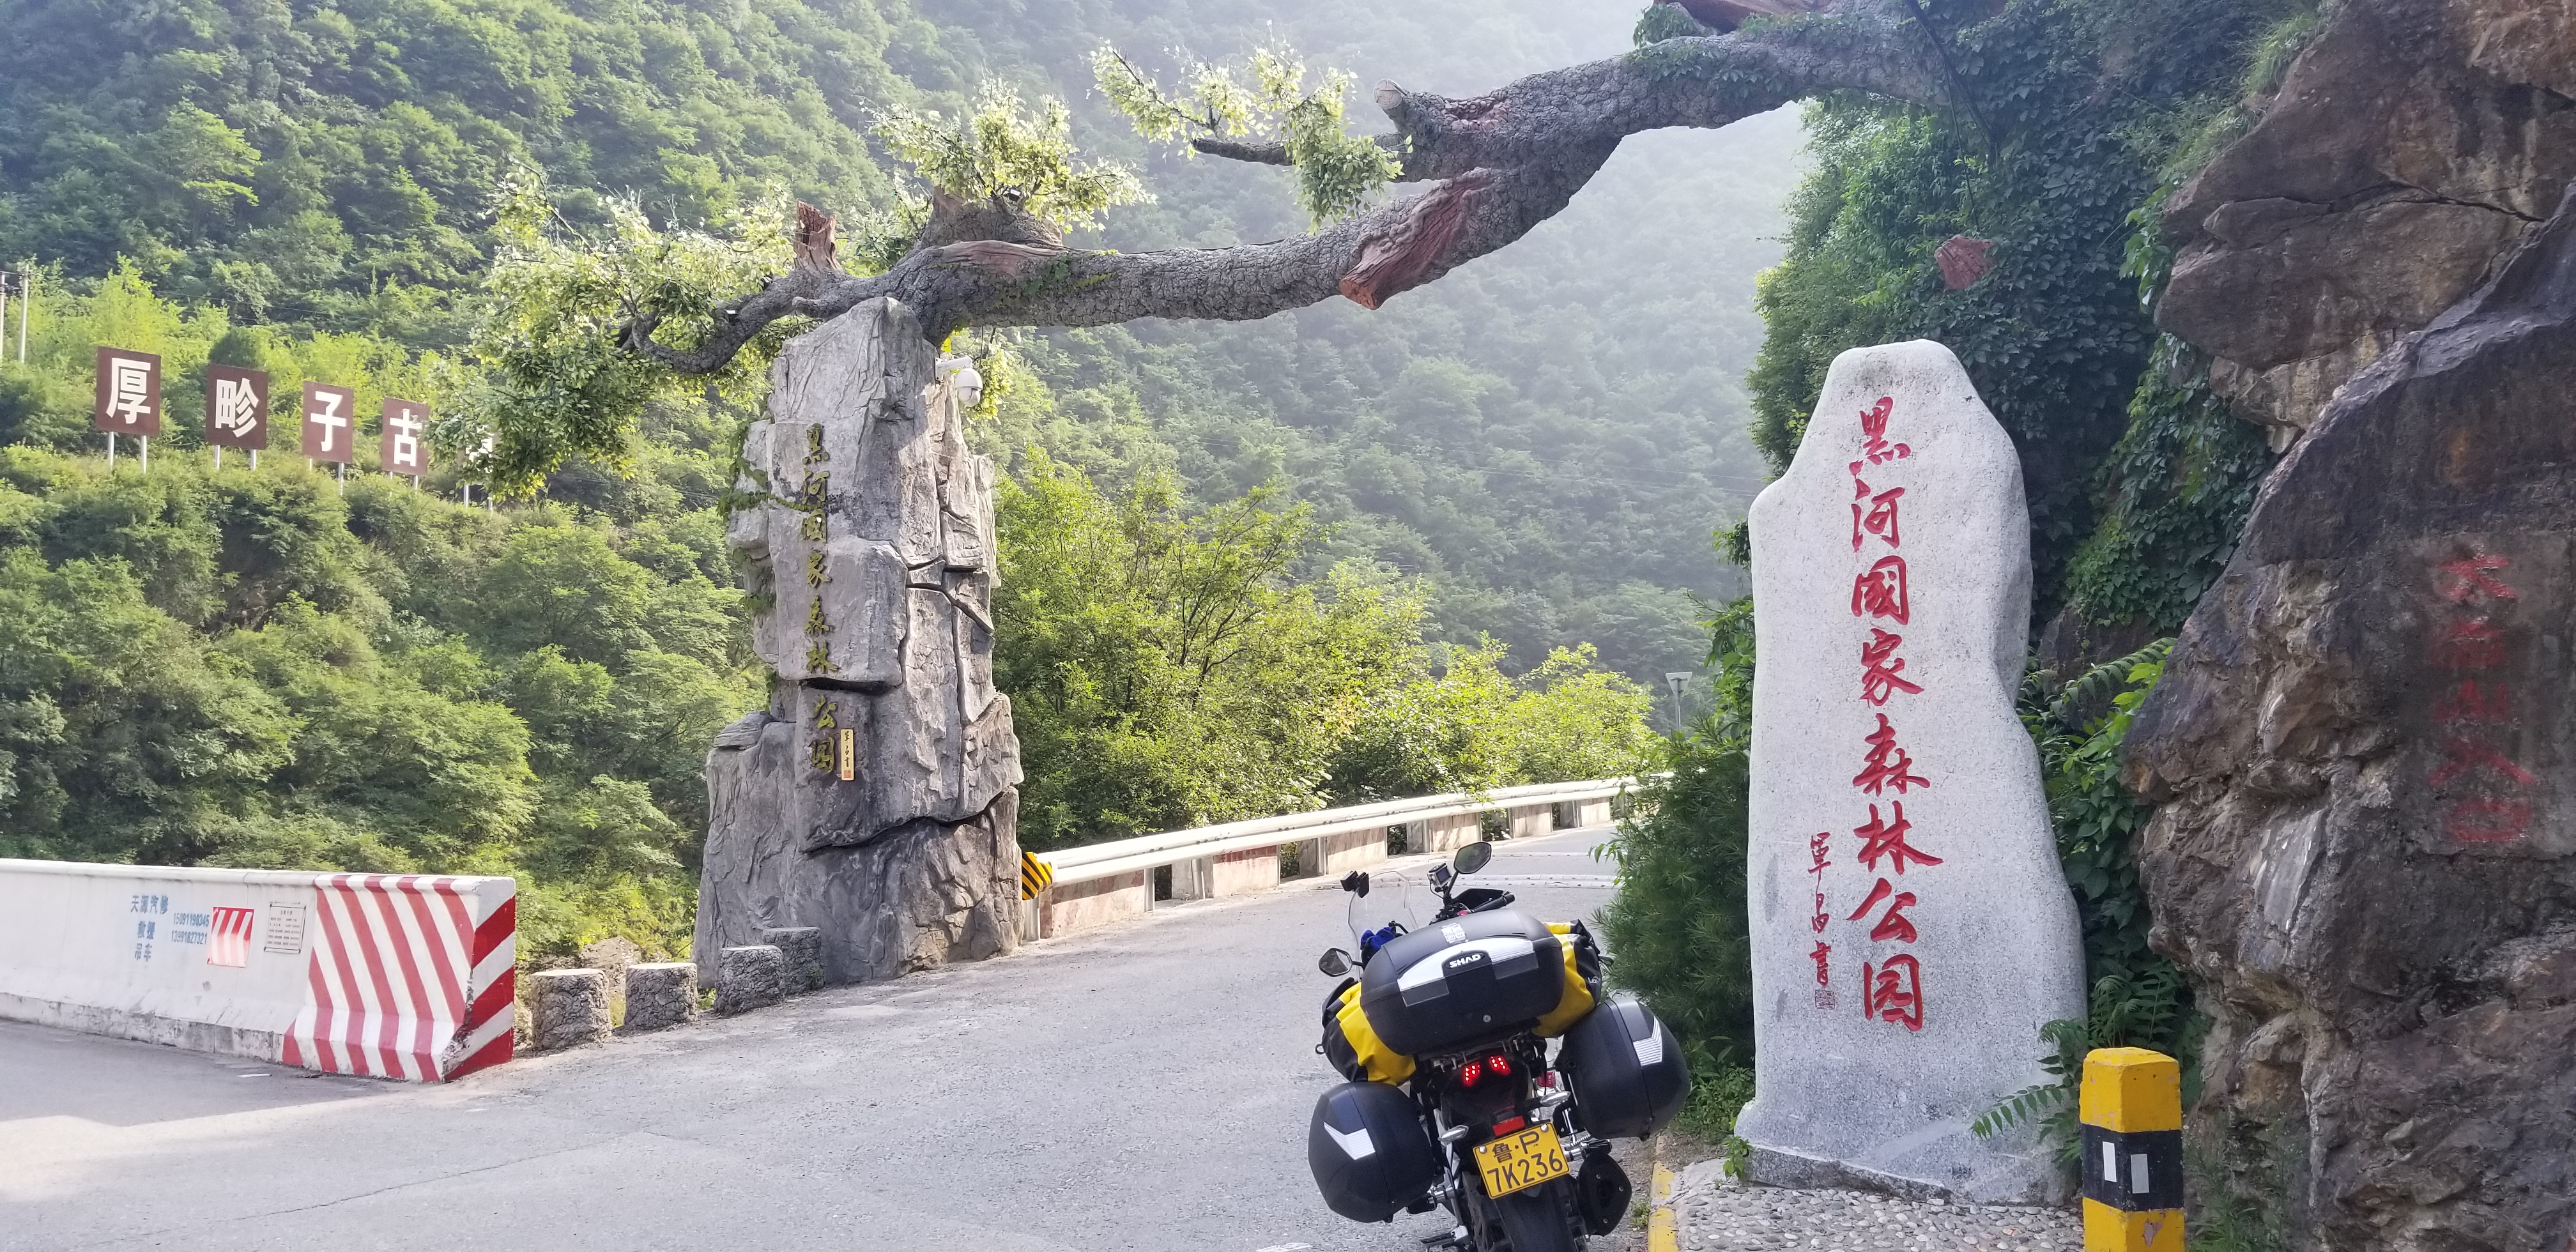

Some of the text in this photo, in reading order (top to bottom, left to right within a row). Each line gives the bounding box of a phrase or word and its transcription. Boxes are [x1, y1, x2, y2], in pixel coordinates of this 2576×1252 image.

[130, 894, 169, 915] 天源汽修
[135, 943, 153, 962] 吊车
[1449, 954, 1482, 968] SHAD
[1487, 1149, 1563, 1193] 7K236
